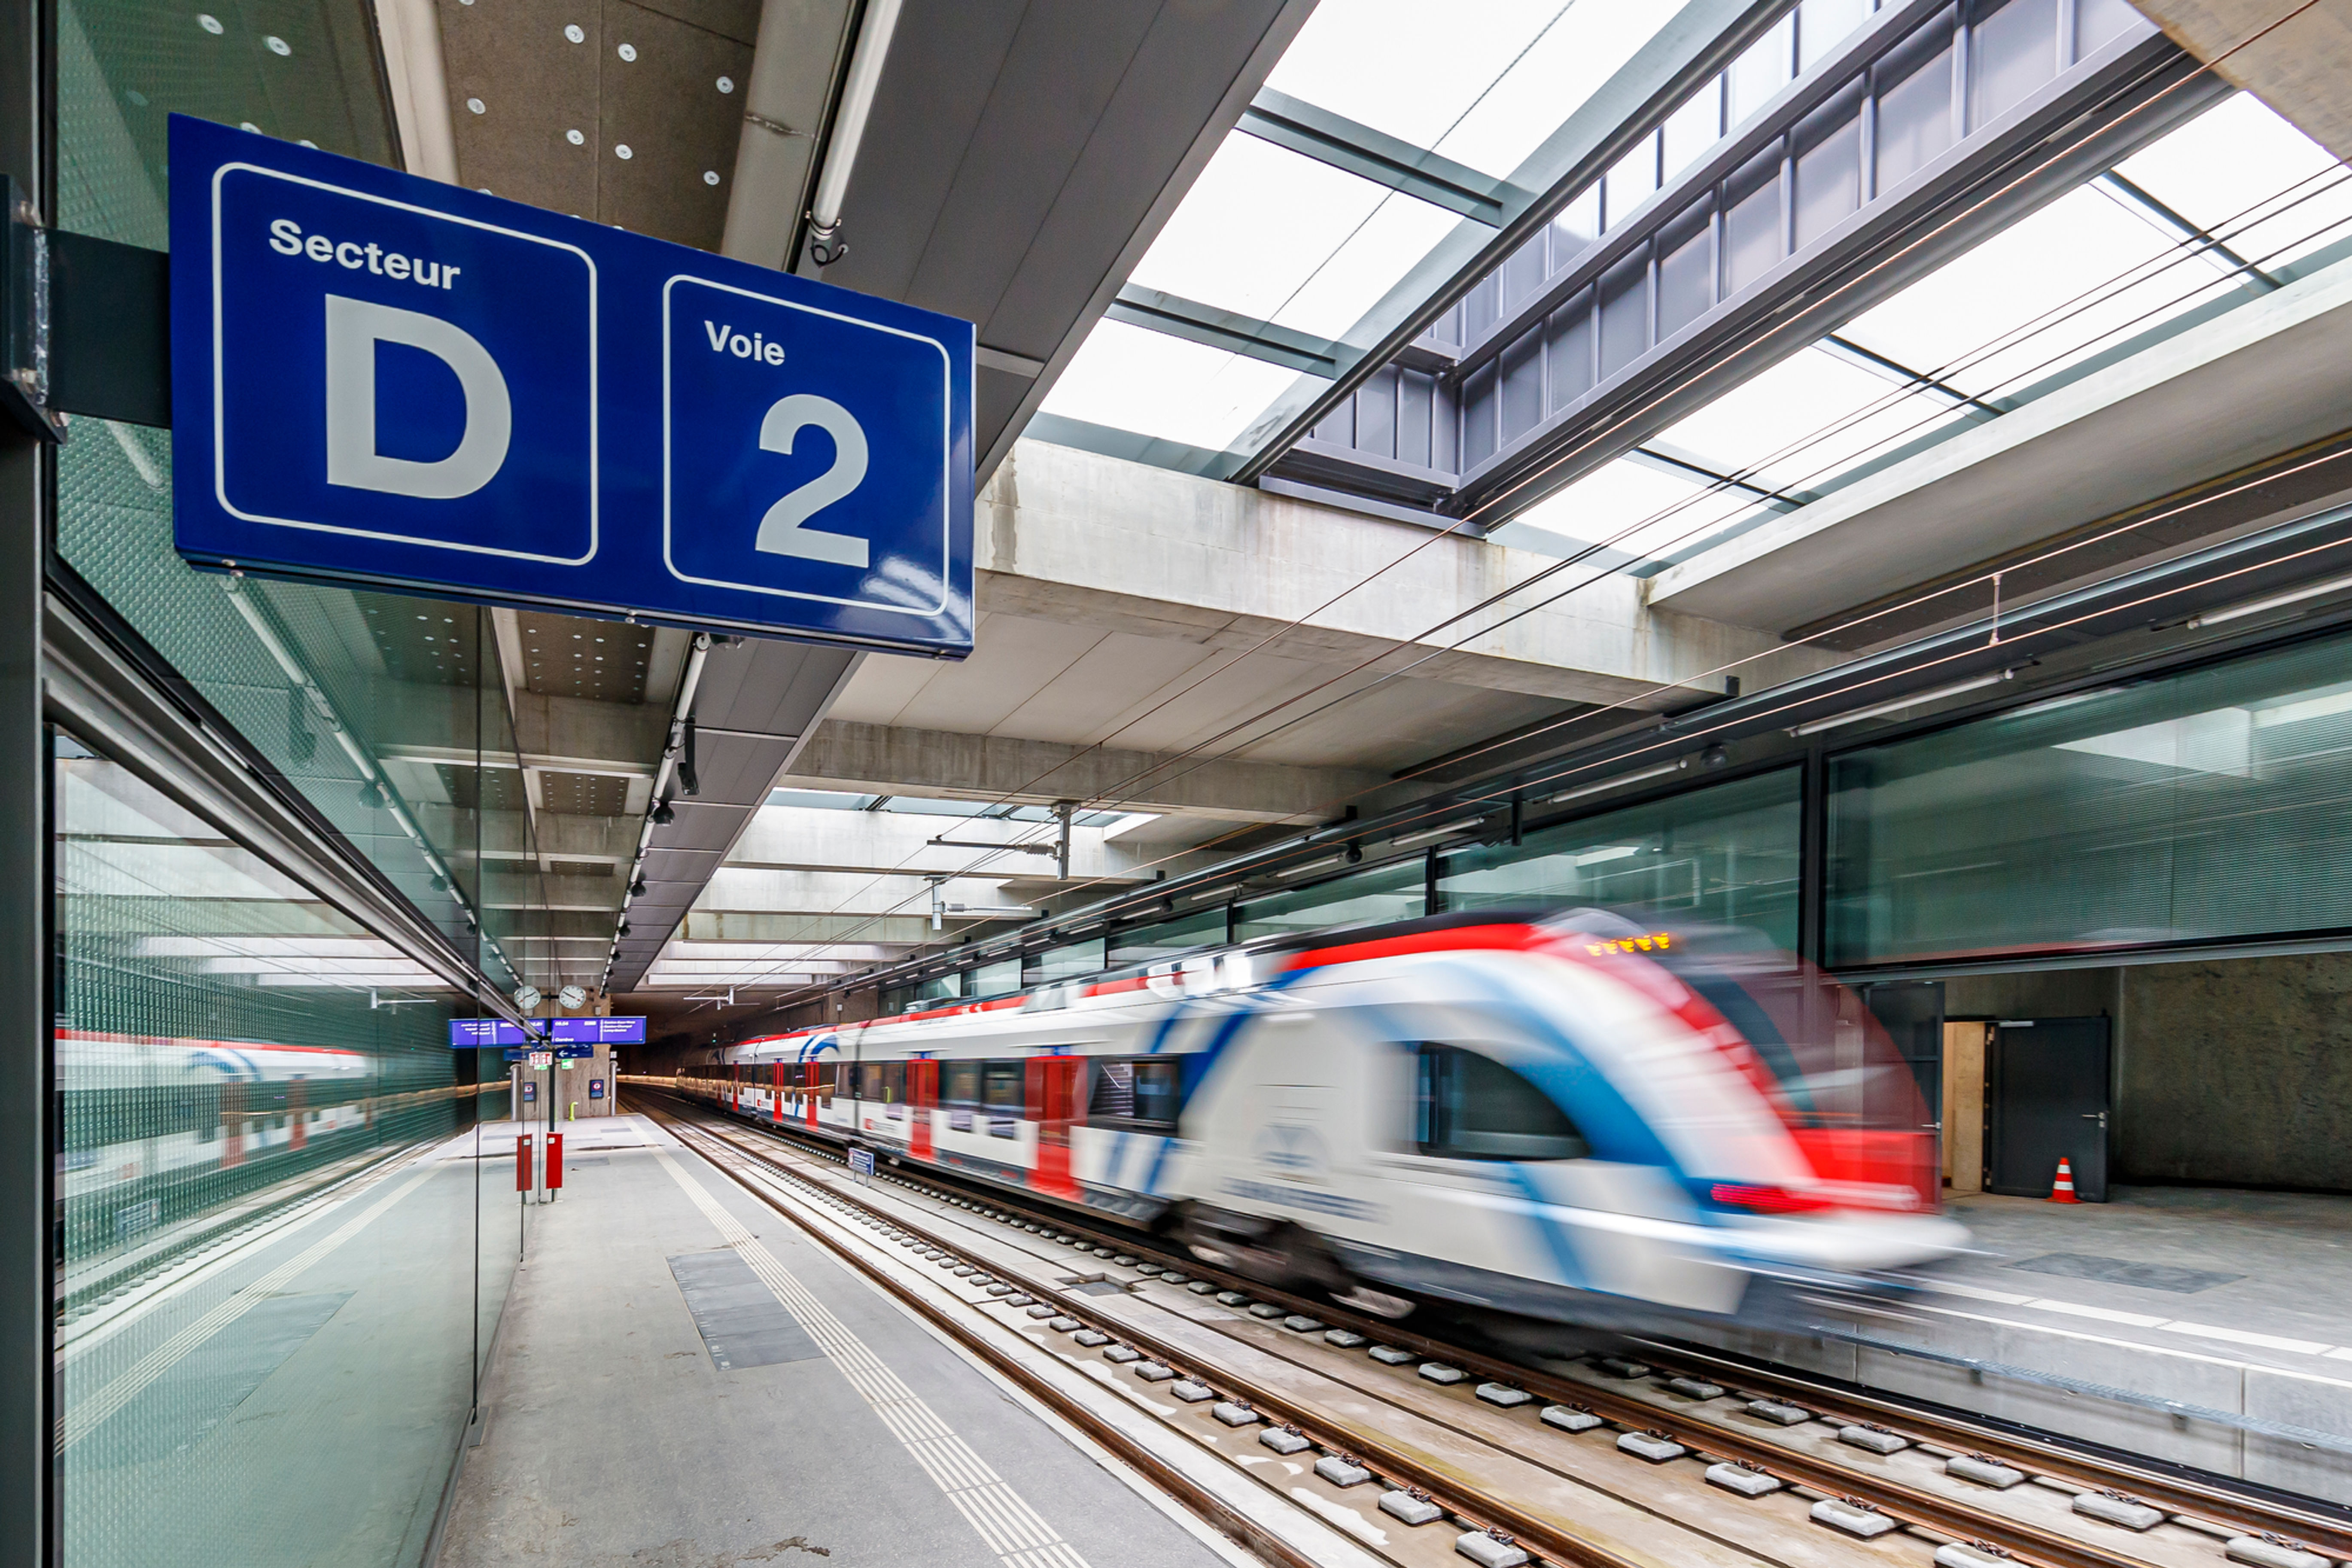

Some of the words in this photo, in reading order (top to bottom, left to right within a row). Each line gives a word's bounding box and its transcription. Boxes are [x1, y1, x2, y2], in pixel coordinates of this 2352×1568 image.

[270, 219, 460, 289] Secteur
[326, 294, 511, 499] D
[705, 320, 785, 365] Voie
[755, 394, 868, 568] 2
